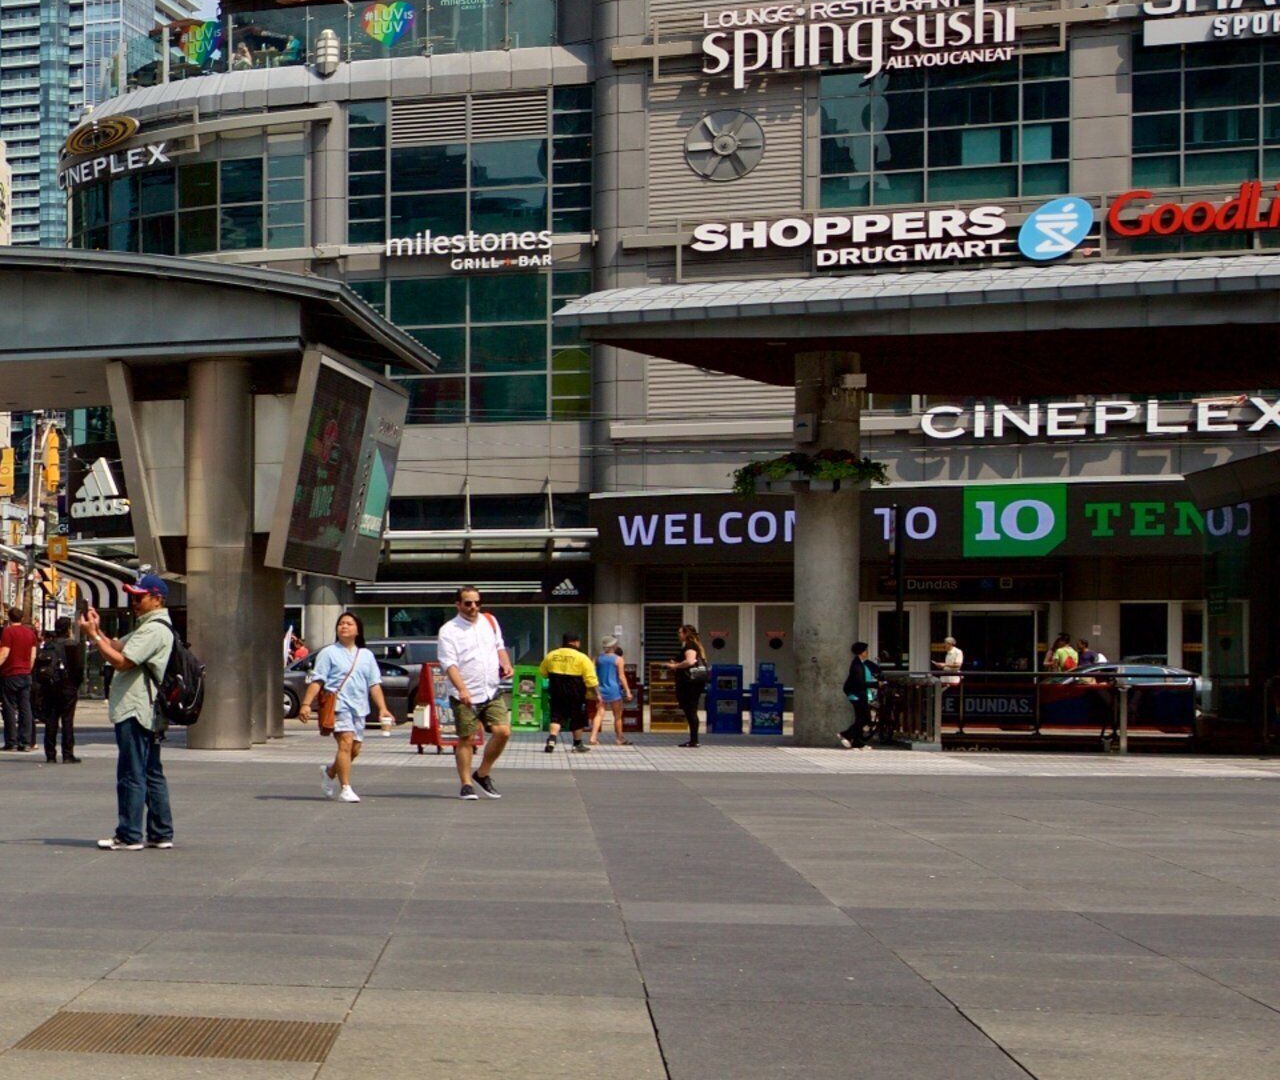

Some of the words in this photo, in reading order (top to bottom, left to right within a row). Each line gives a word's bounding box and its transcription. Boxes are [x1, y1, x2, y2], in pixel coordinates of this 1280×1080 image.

[373, 21, 404, 34] LUV
[703, 5, 794, 29] LOUNGE
[188, 40, 213, 54] LUV
[58, 143, 170, 190] CINEPLEX
[691, 206, 1007, 252] SHOPPERS
[386, 229, 554, 259] milestones
[816, 244, 909, 267] DRUG
[913, 239, 1005, 261] MART
[450, 256, 501, 270] GRILL
[518, 253, 553, 268] BAR
[920, 397, 1280, 439] CINEPLEX
[71, 498, 130, 519] adidas
[874, 506, 938, 541] TO
[974, 499, 1056, 541] 10
[552, 588, 580, 596] adidas
[907, 579, 958, 590] Dundas
[965, 698, 1033, 713] DUNDAS.
